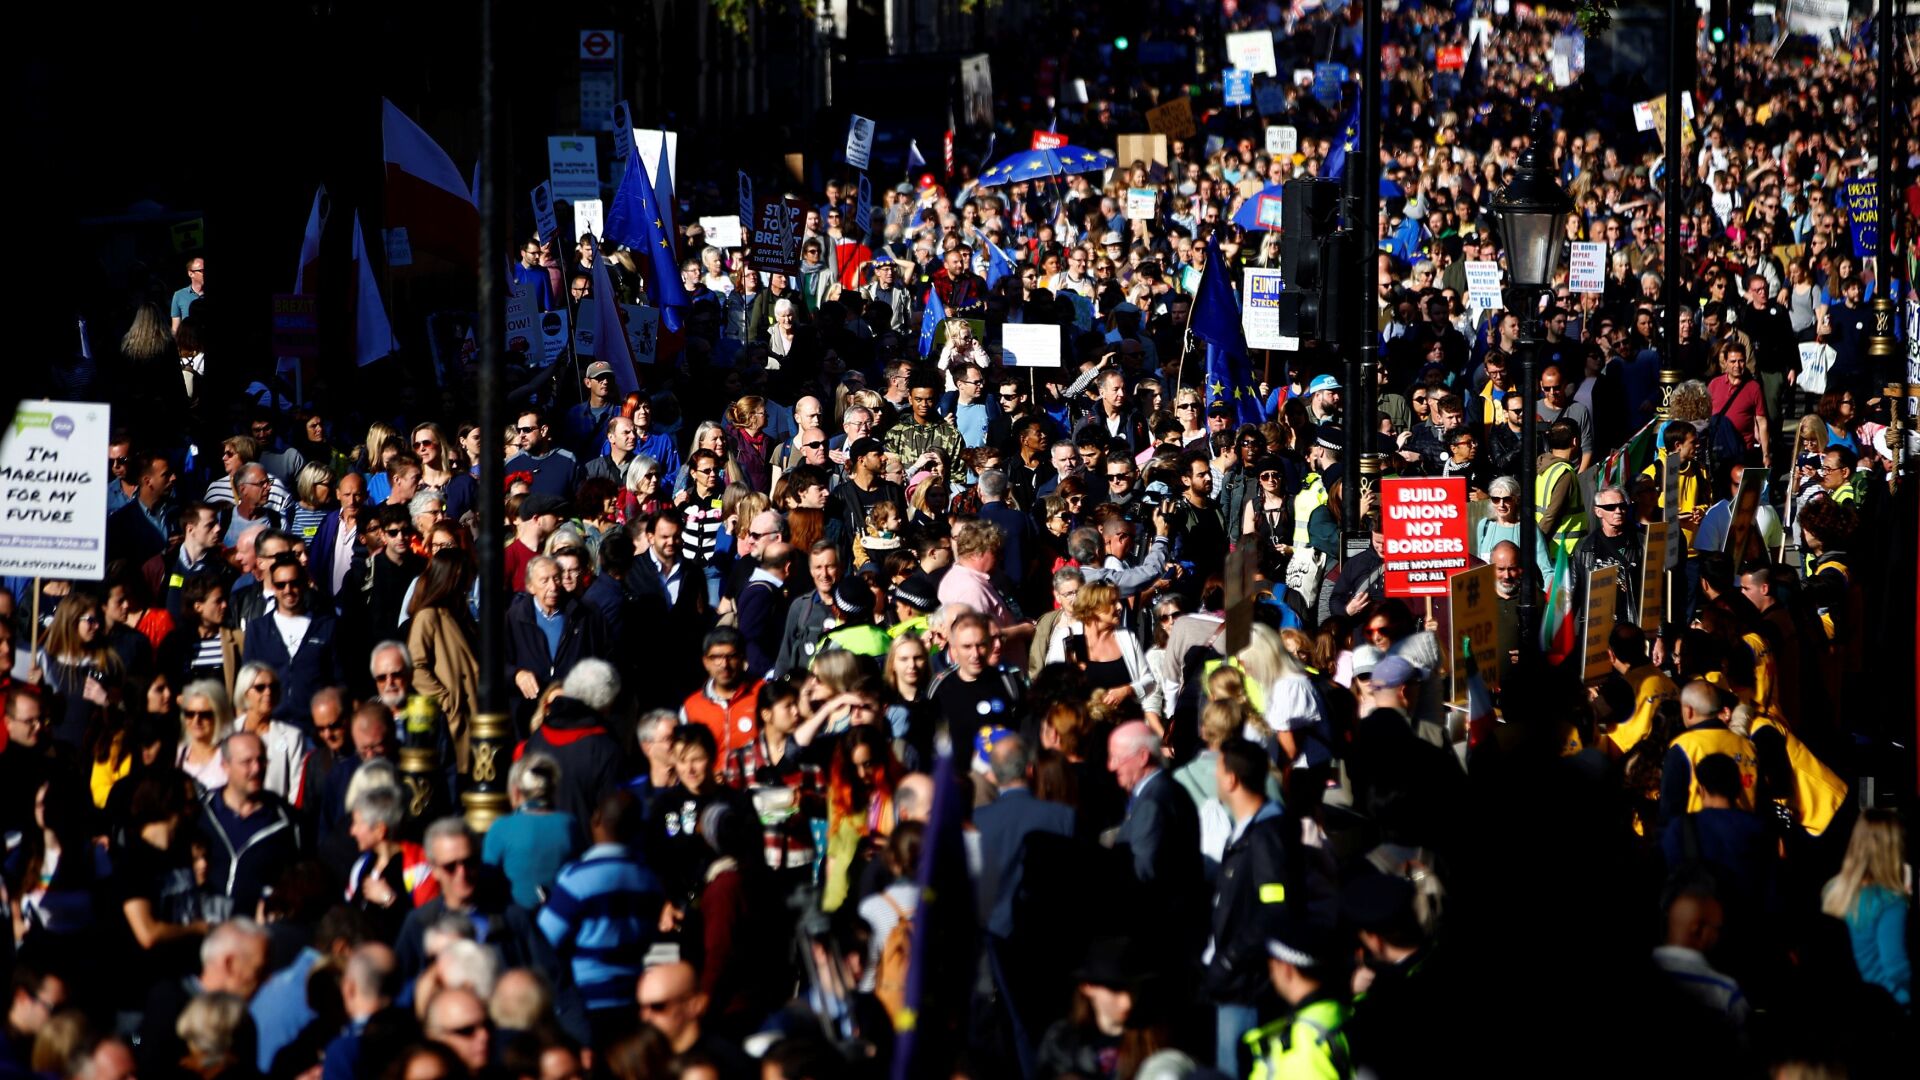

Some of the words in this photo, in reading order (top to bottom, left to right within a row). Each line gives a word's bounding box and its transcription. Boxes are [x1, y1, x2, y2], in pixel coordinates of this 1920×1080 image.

[762, 217, 798, 233] TOY
[1480, 297, 1491, 307] EU
[25, 446, 58, 462] I'M
[6, 488, 42, 502] FOR
[49, 490, 77, 503] MY
[1398, 487, 1448, 503] BUILD
[6, 507, 75, 524] FUTURE
[1389, 504, 1459, 519] UNIONS
[1406, 522, 1444, 536] NOT
[1387, 538, 1464, 554] BORDERS
[1387, 561, 1410, 571] FREE
[1411, 558, 1466, 570] MOVEMENT
[1408, 572, 1428, 582] FOR
[1428, 571, 1446, 581] ALL
